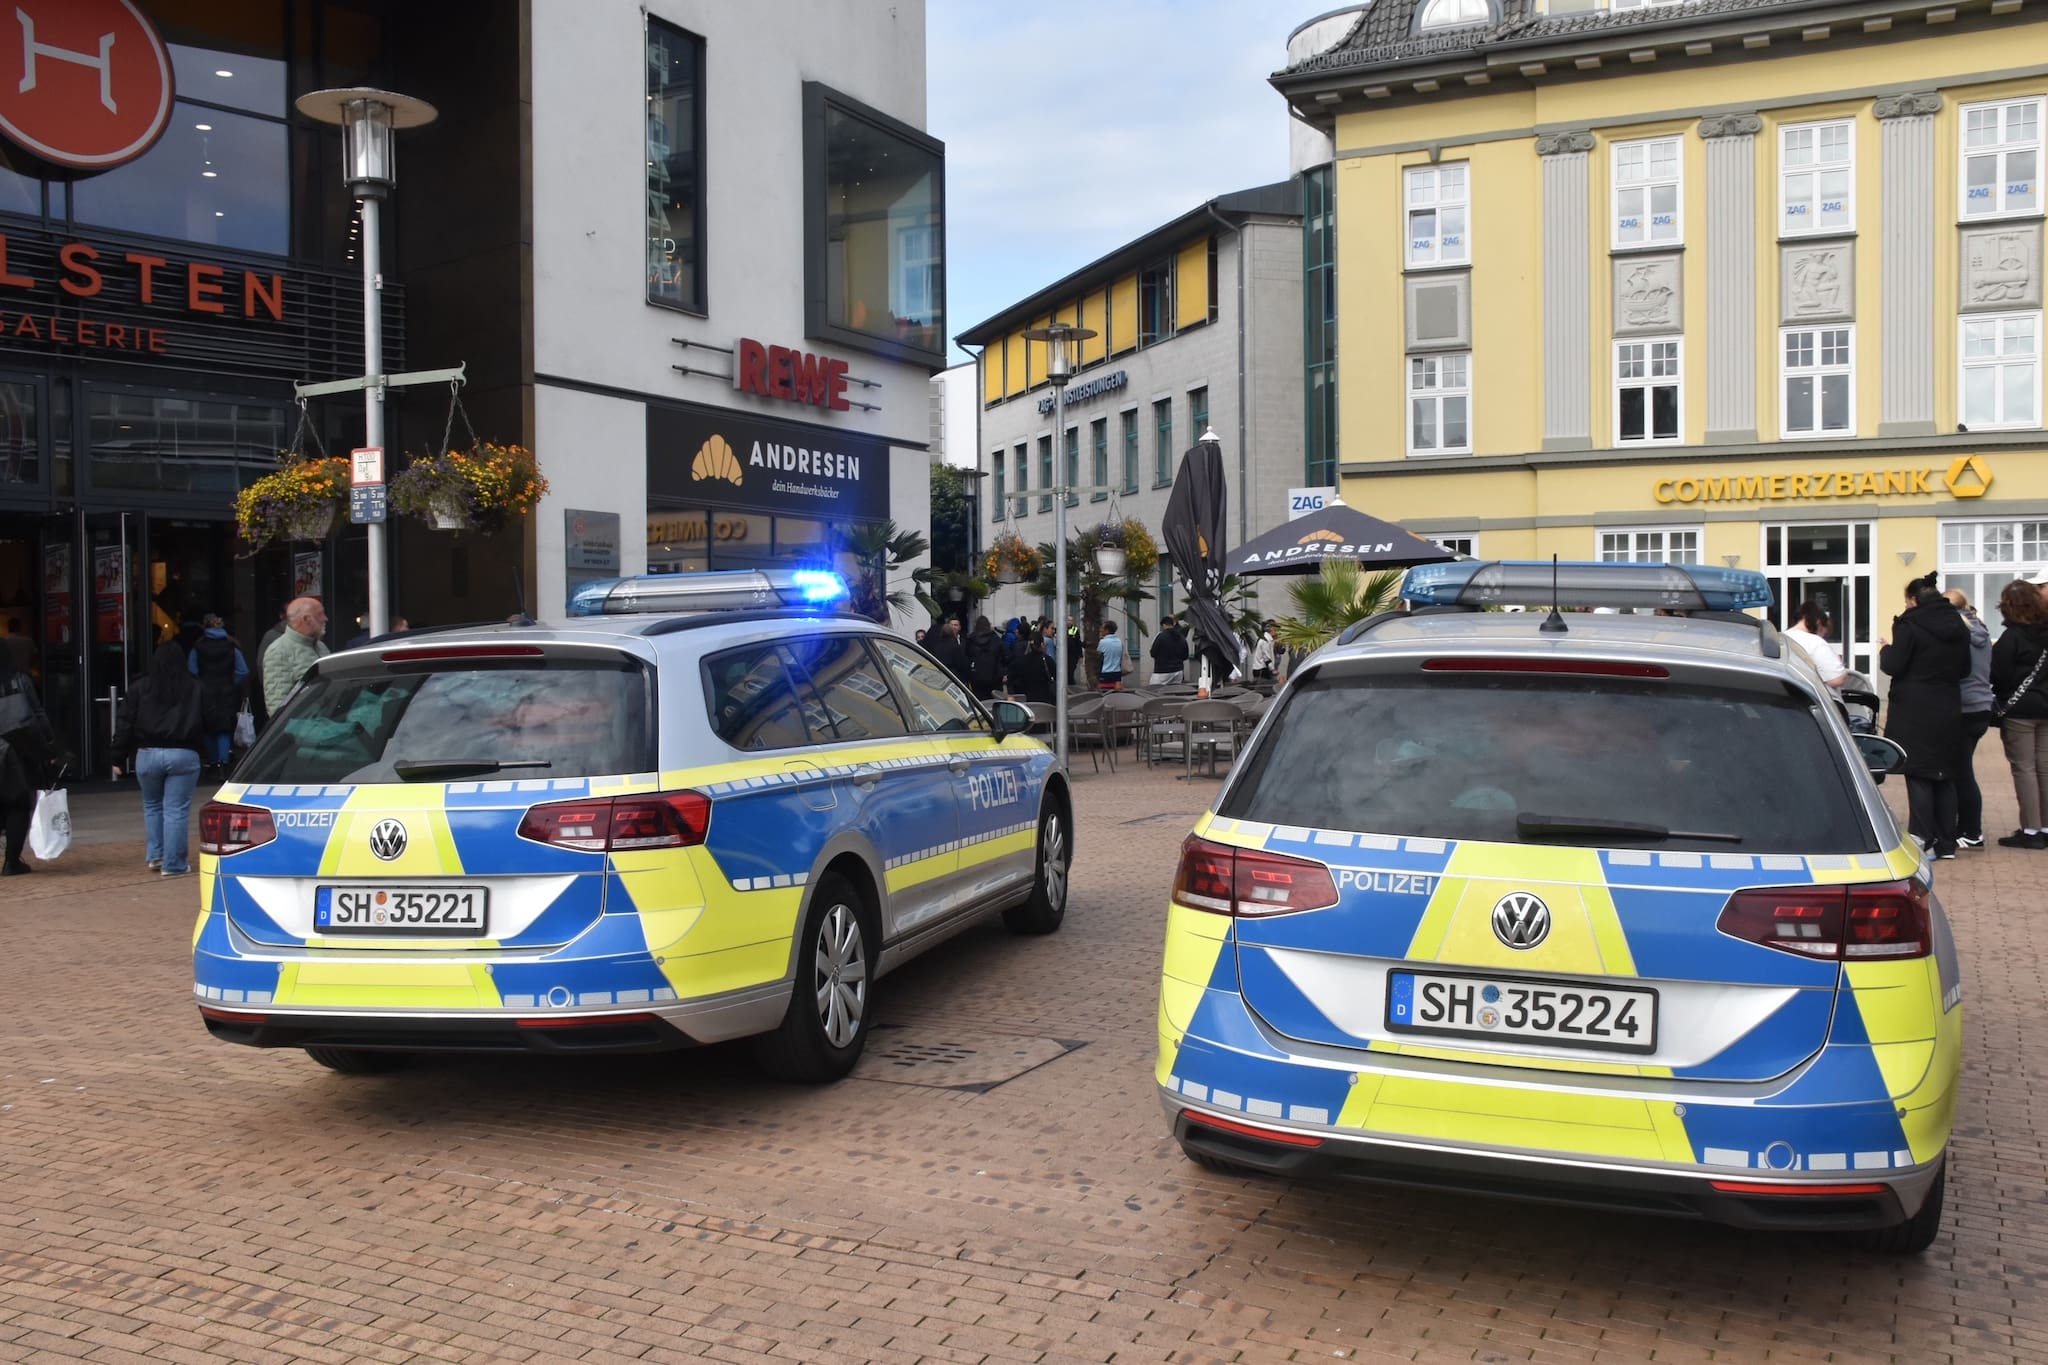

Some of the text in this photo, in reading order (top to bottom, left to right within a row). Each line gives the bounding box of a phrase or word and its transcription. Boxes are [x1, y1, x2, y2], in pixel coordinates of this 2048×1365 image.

[1968, 188, 1989, 198] ZAG
[2008, 184, 2029, 194] ZAG
[1822, 202, 1841, 211] ZAG
[1620, 219, 1638, 228] ZAG
[1653, 216, 1671, 225] ZAG
[0, 311, 168, 353] ALERIE
[739, 338, 850, 411] REWE
[749, 440, 860, 481] ANDRESEN
[772, 480, 840, 499] dein Handwerksbäcker
[1653, 467, 1931, 503] COMMERZBANK
[1292, 495, 1323, 511] ZAG
[1243, 543, 1393, 564] ANDRESEN
[967, 769, 1018, 811] POLIZEI
[276, 813, 334, 828] POLIZEI
[1339, 870, 1433, 896] POLIZEI
[336, 893, 477, 923] SH 35221
[1396, 1004, 1406, 1016] D
[1420, 982, 1639, 1038] SH 35224
